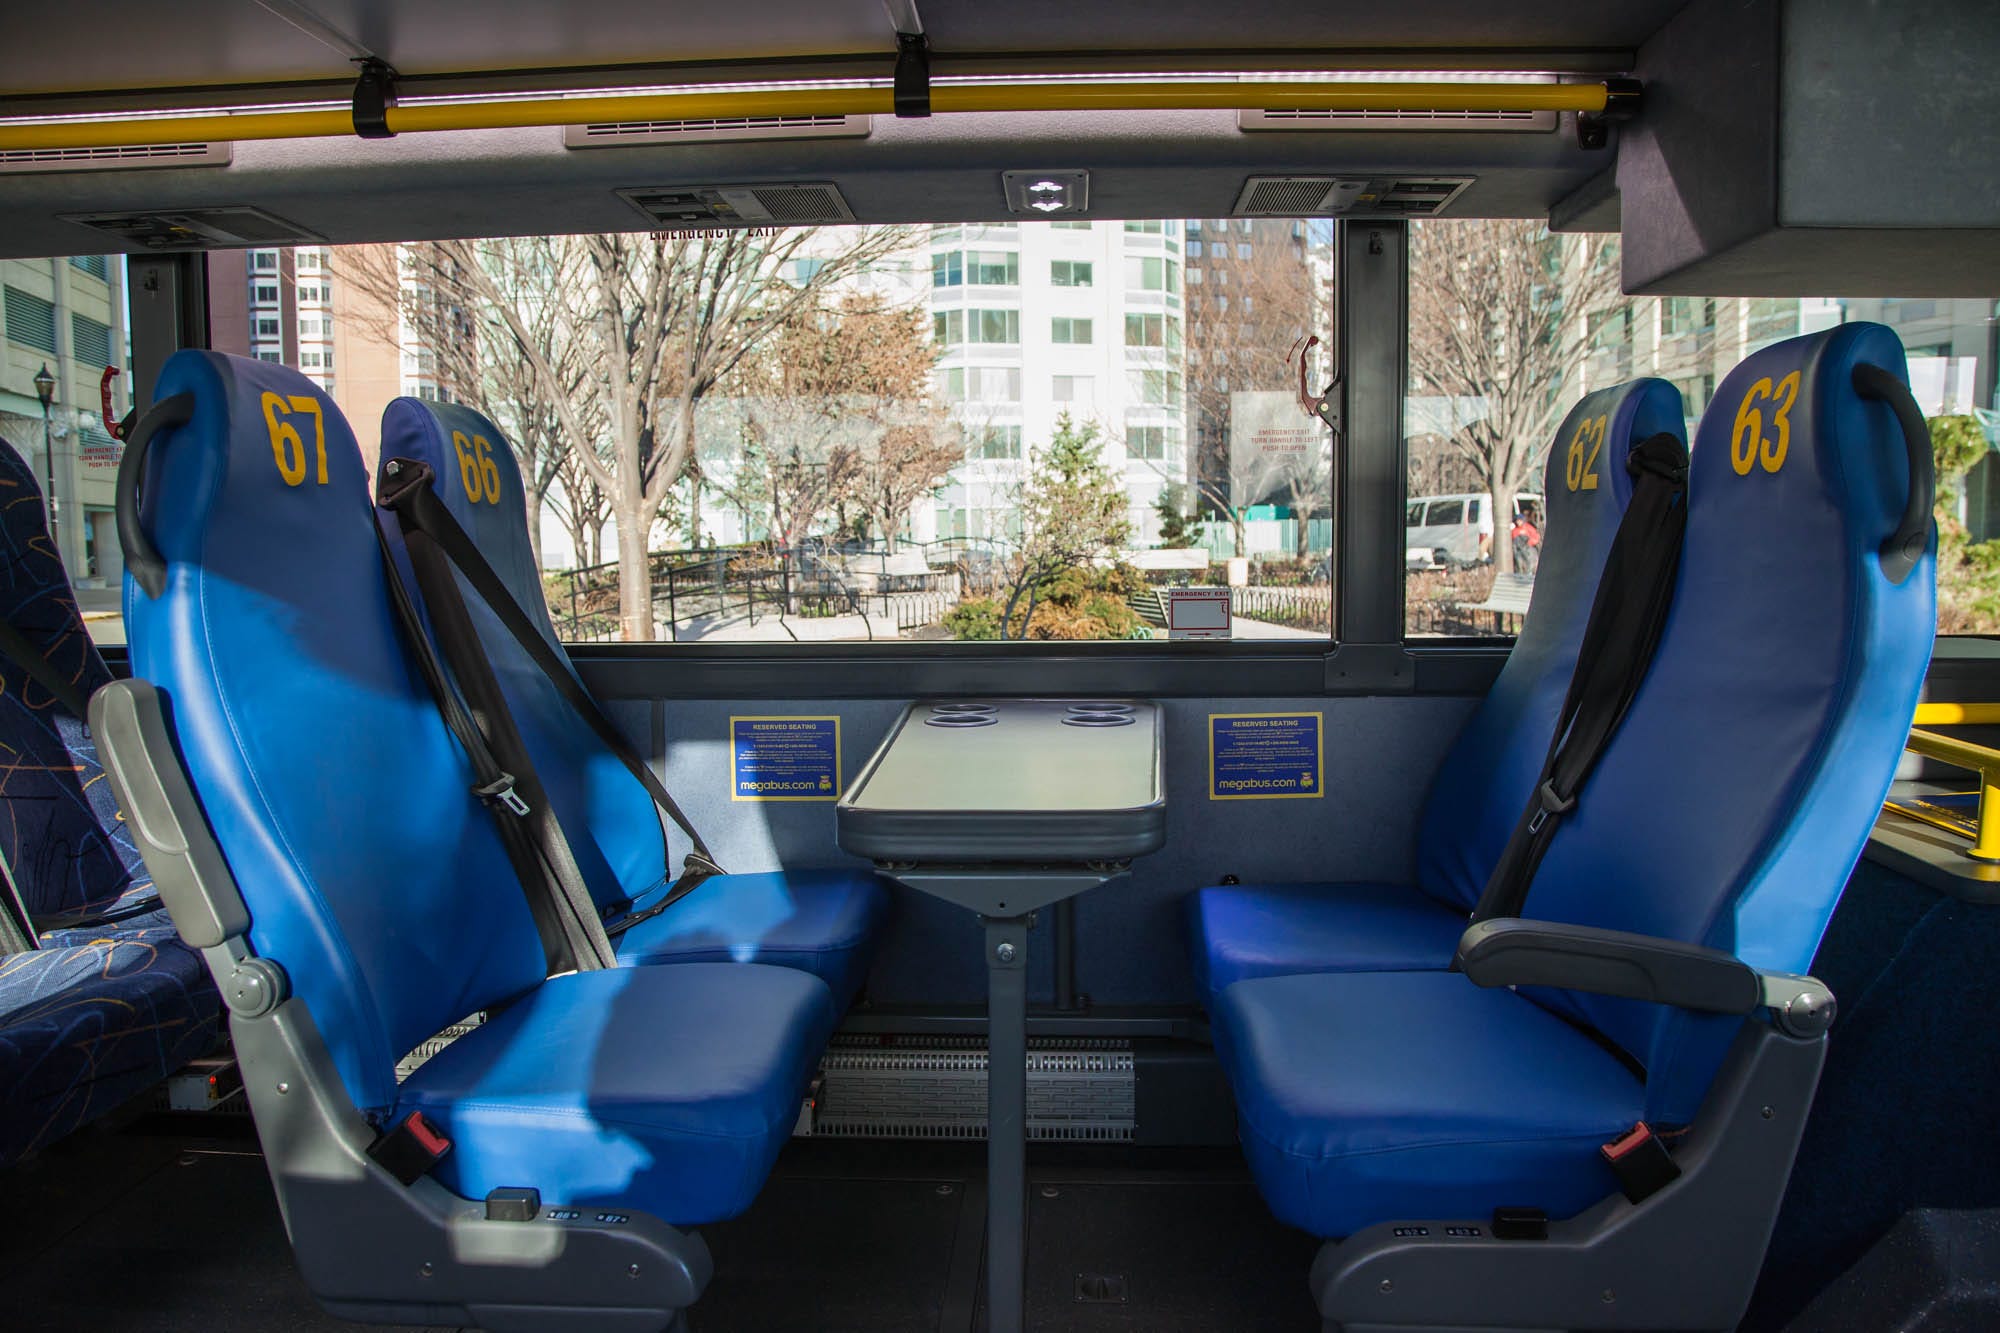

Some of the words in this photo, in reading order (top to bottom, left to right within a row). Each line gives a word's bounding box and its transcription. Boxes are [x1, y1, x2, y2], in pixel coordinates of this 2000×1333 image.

[261, 391, 328, 487] 67
[1566, 414, 1607, 492] 62
[1730, 370, 1801, 476] 63
[452, 430, 501, 505] 66
[1270, 719, 1299, 727] SEATING
[740, 780, 815, 792] megabus.com
[1219, 778, 1296, 790] megabus.com
